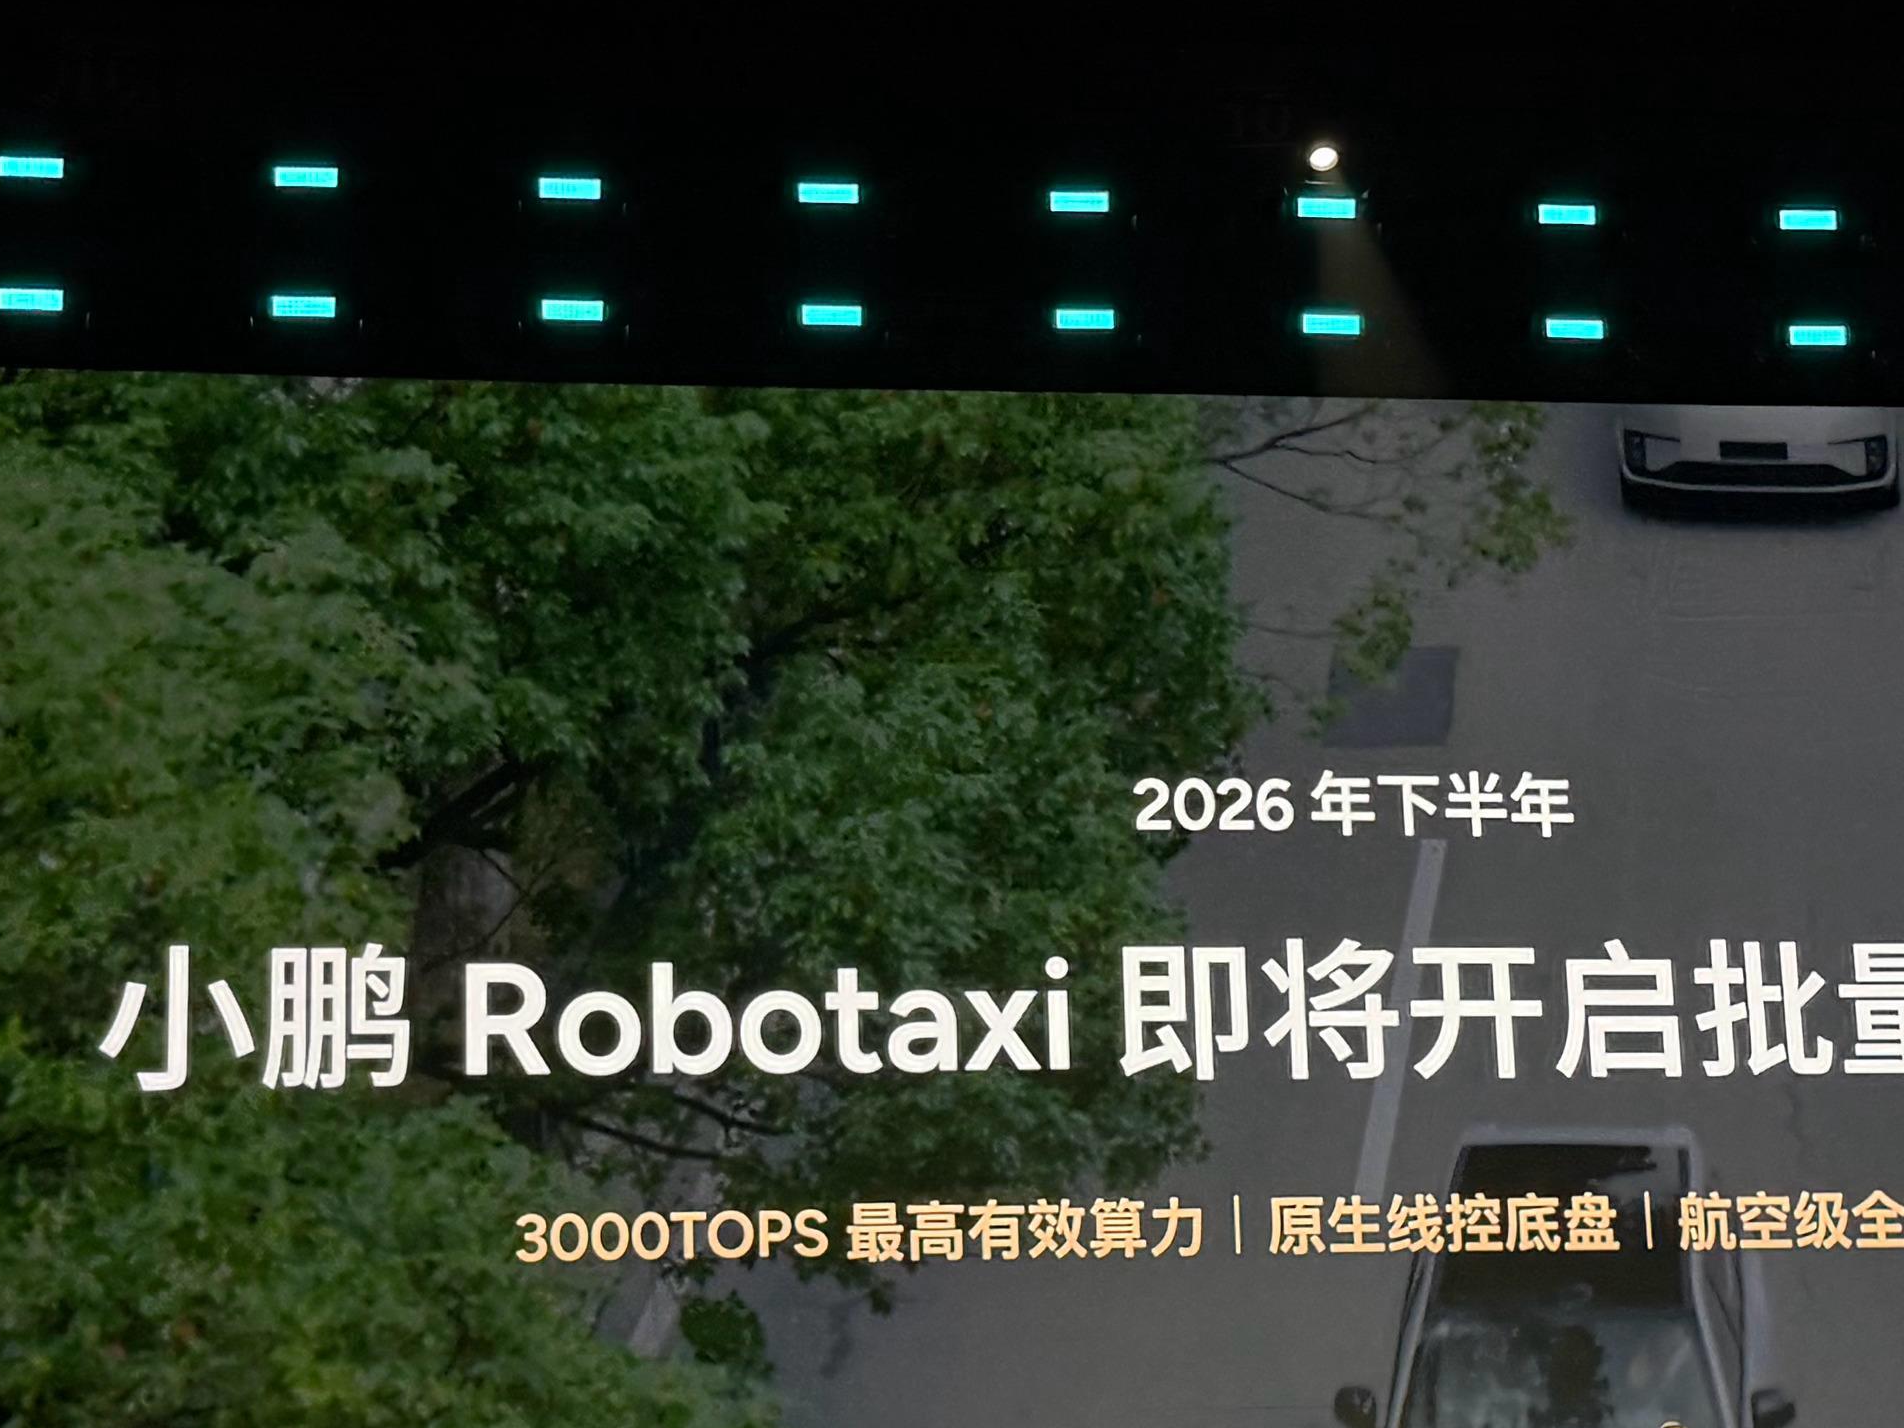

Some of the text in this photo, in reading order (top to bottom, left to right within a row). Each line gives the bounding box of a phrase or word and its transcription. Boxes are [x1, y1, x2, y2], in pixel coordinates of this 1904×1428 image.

[1132, 769, 1575, 838] 2026 年下半年
[98, 942, 410, 1092] 小鹏
[465, 955, 1071, 1076] Robotaxi
[515, 1209, 829, 1263] 3000TOPS
[846, 1196, 1202, 1263] 最高有效算力
[1269, 1191, 1621, 1255] 原生线控底盘
